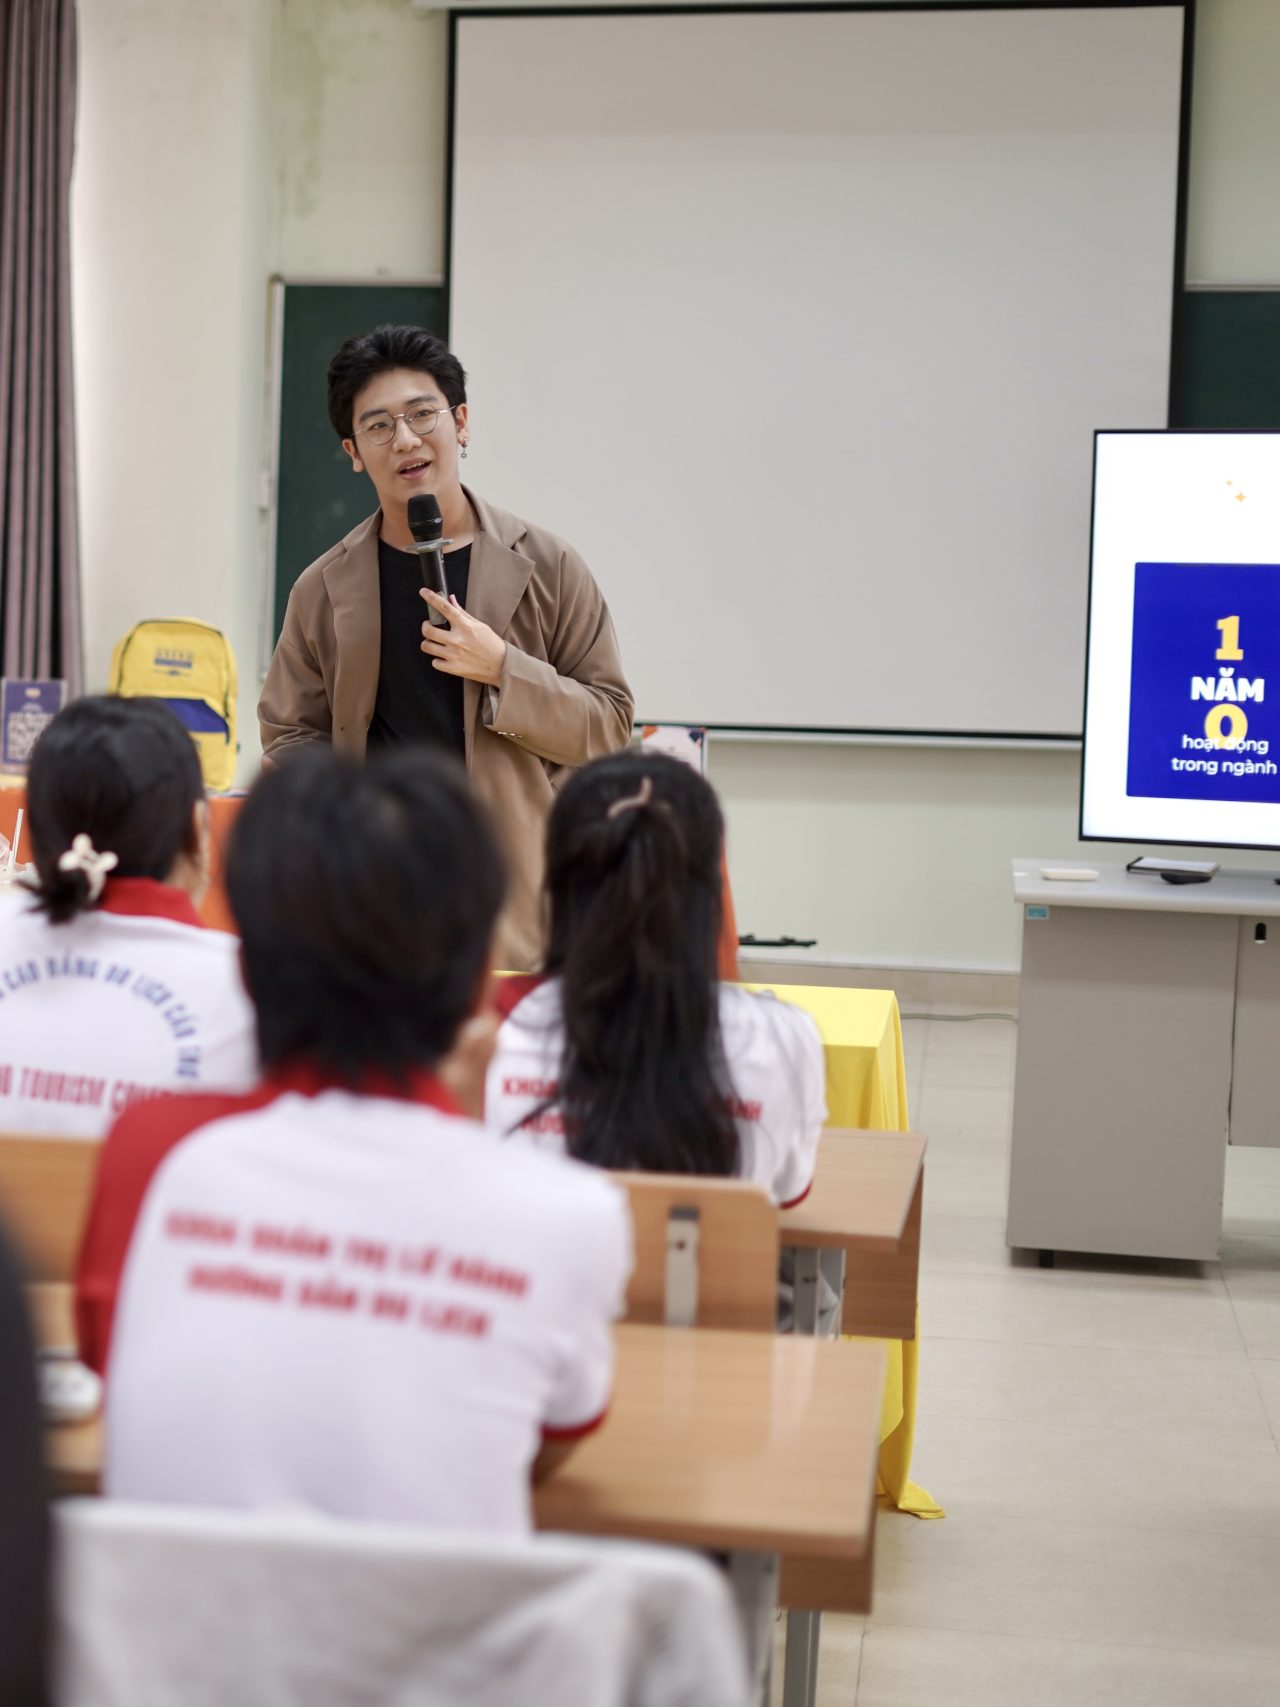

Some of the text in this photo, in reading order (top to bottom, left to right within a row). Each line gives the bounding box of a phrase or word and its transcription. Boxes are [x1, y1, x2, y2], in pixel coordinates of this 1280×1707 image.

[1215, 615, 1244, 661] 1
[1190, 666, 1266, 703] NĂM
[1182, 734, 1270, 754] hoạt động
[1171, 757, 1278, 777] trong ngành
[20, 1066, 106, 1107] TOURISM
